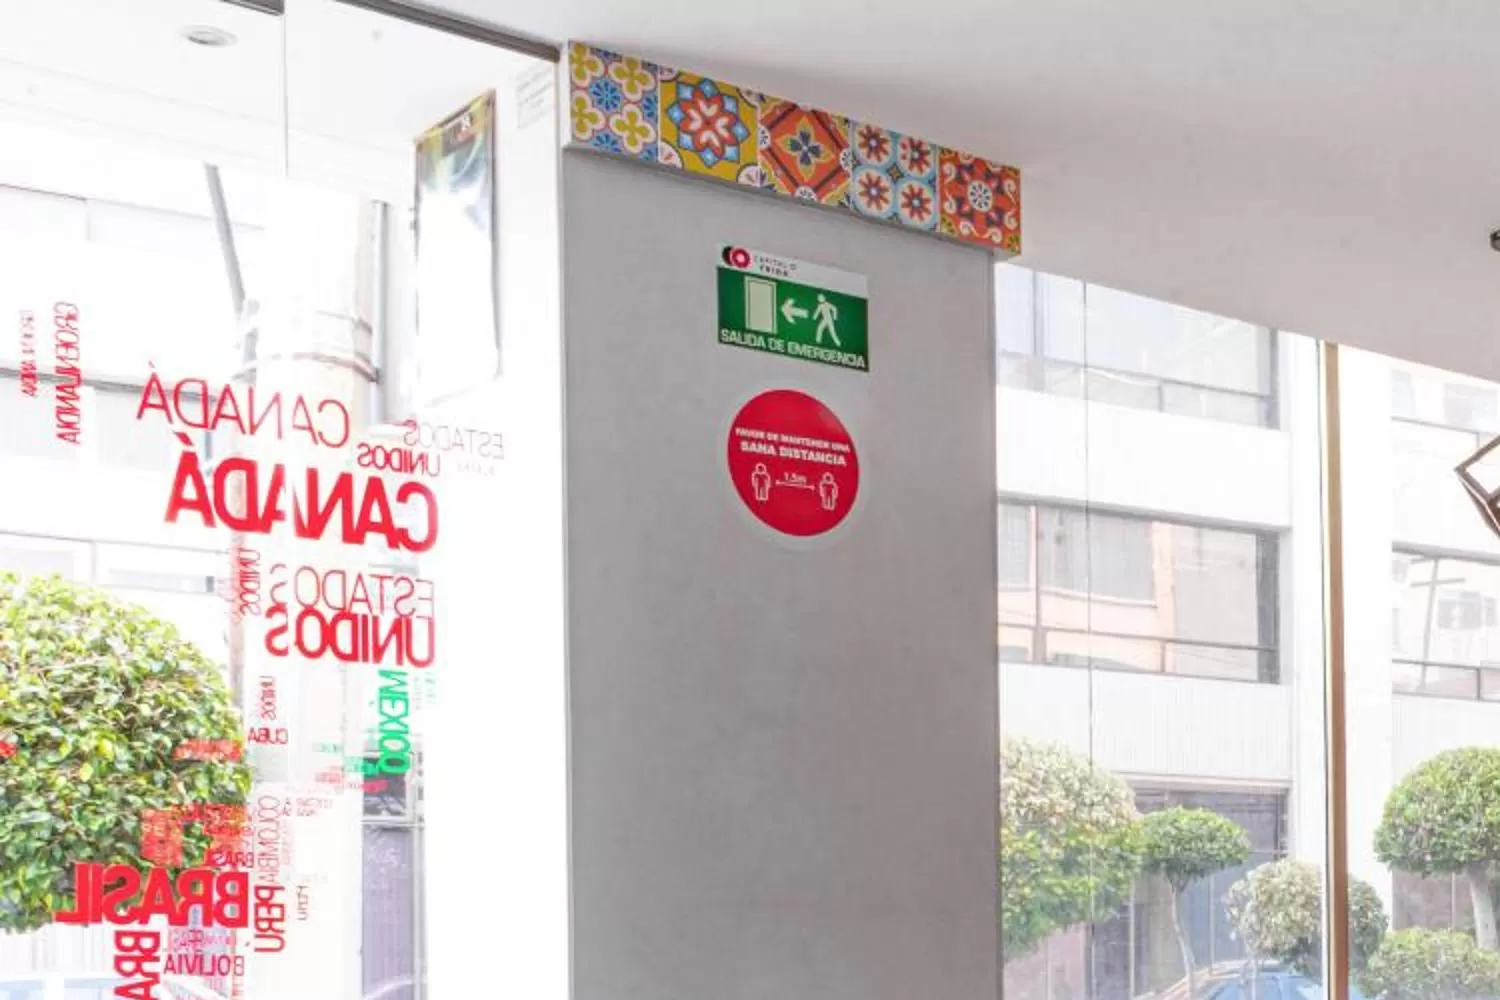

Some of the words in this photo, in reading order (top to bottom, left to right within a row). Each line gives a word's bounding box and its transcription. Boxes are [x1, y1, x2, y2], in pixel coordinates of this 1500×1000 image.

[759, 264, 788, 277] FRIDA
[720, 328, 766, 349] SALIDA
[767, 338, 785, 353] DE
[787, 341, 866, 368] EMERGENCIA
[735, 426, 765, 441] FAVOR
[767, 432, 779, 443] DE
[781, 433, 830, 450] MANTENER
[831, 442, 850, 453] UNA
[740, 440, 776, 457] SANA
[779, 446, 847, 467] DISTANCIA
